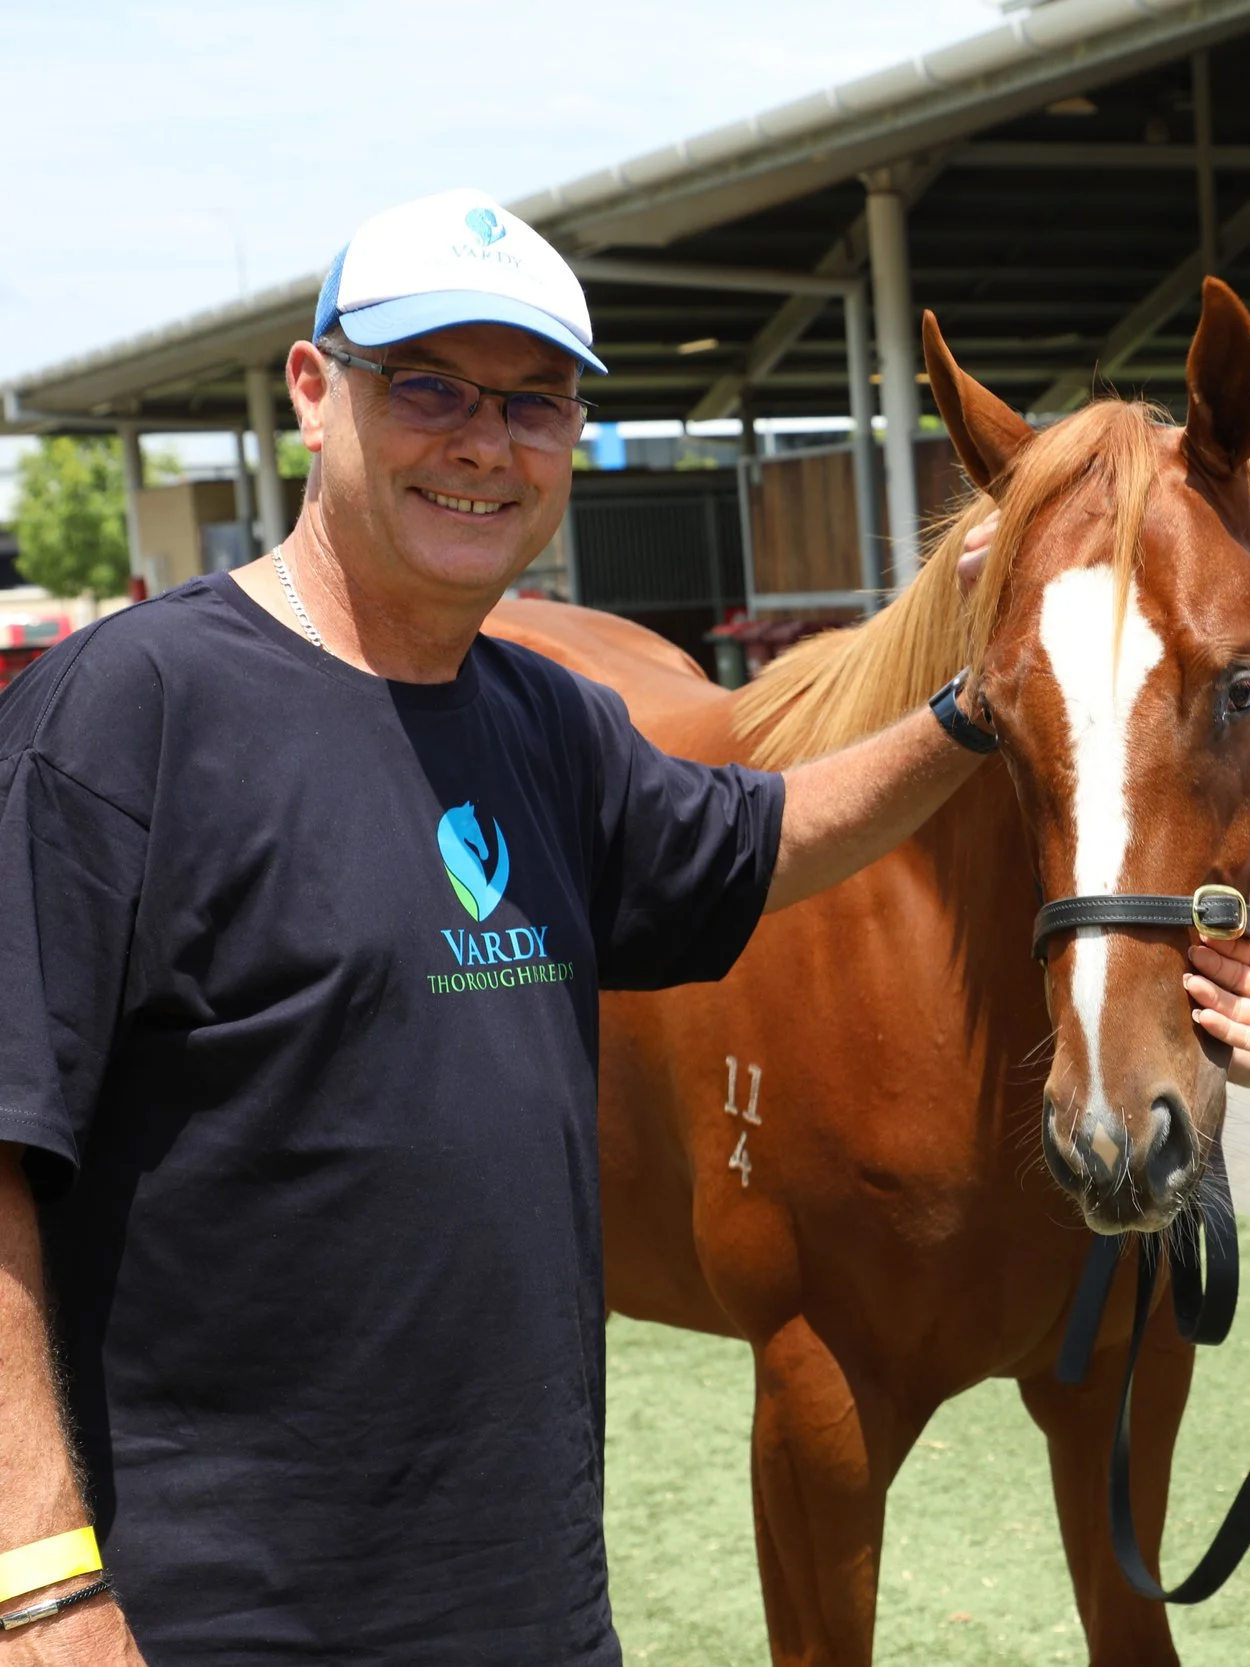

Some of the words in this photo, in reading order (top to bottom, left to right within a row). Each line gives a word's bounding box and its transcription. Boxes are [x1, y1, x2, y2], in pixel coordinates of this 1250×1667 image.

[452, 245, 522, 268] VARDY
[440, 925, 548, 967] VARDY
[427, 961, 574, 994] THOROUGHBREDS
[724, 1055, 762, 1125] 11
[728, 1131, 752, 1188] 4
